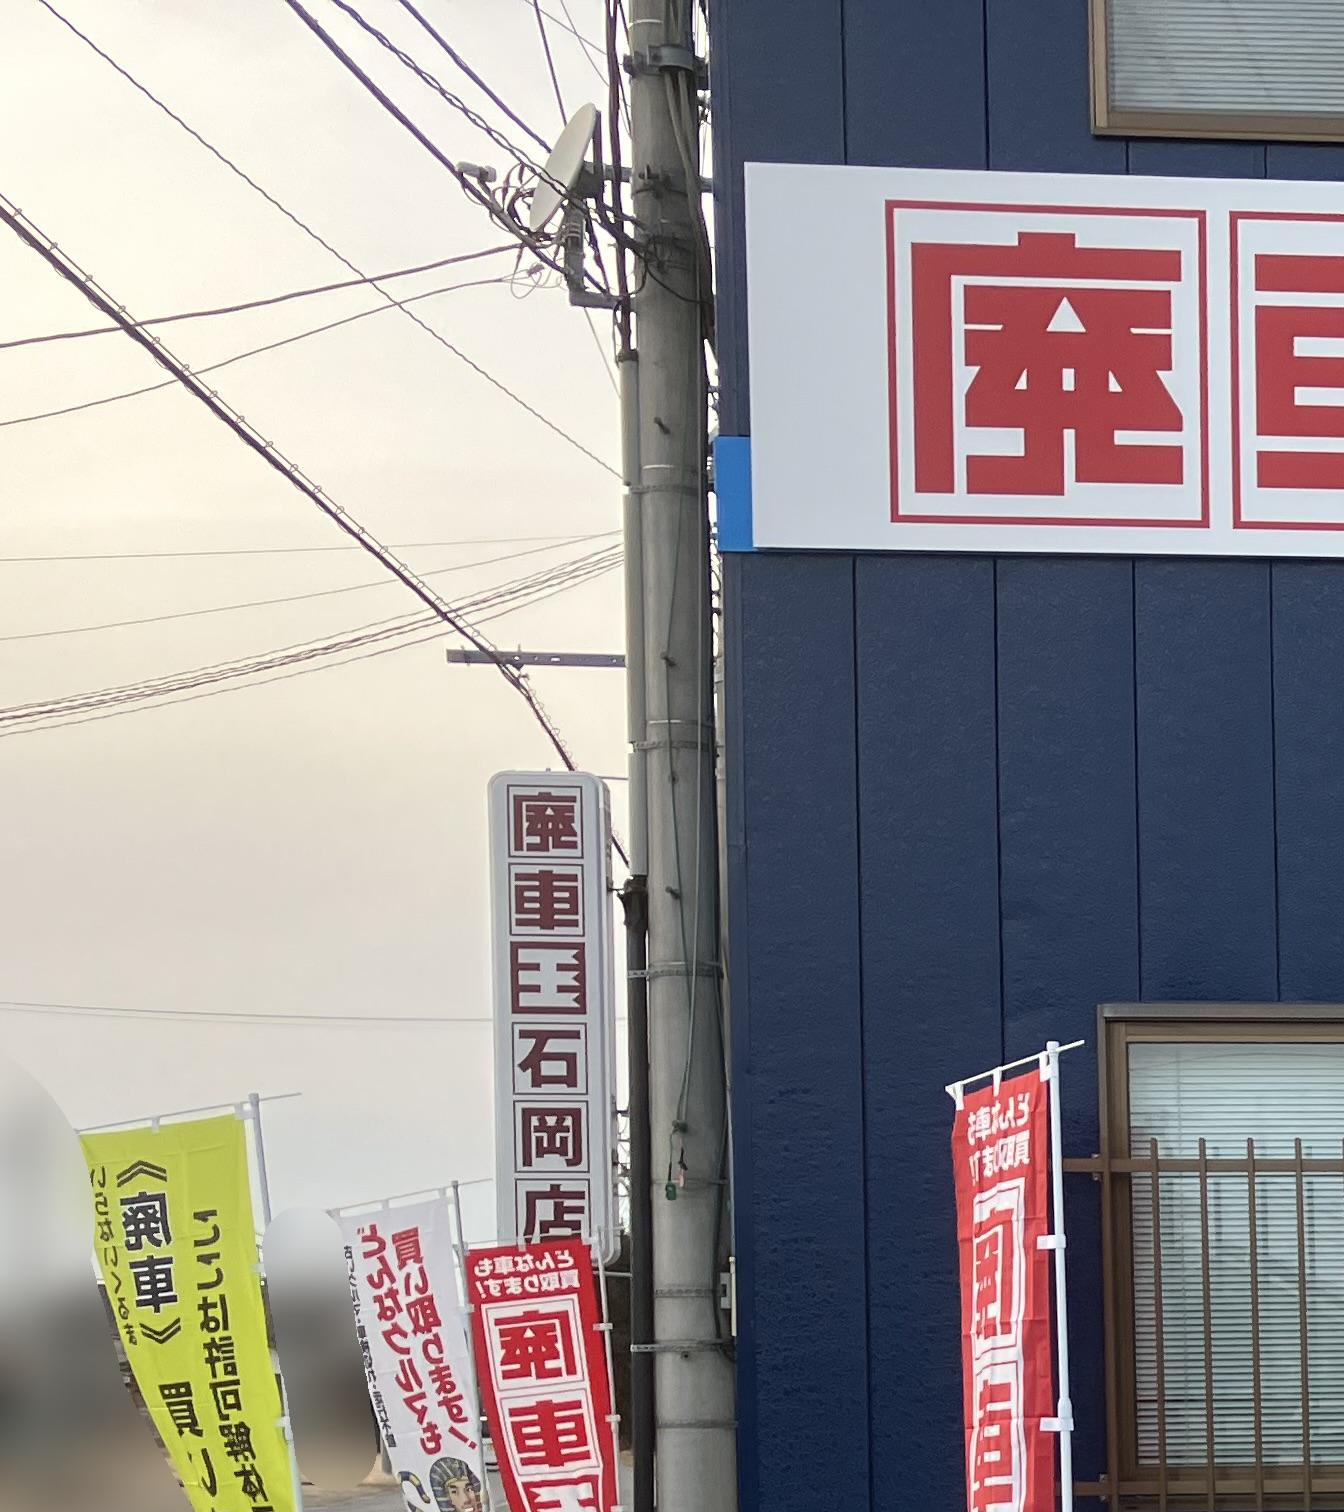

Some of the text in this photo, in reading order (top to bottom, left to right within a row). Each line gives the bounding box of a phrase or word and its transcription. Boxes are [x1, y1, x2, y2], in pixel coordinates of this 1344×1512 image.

[512, 791, 588, 1243] 廃車王石岡店
